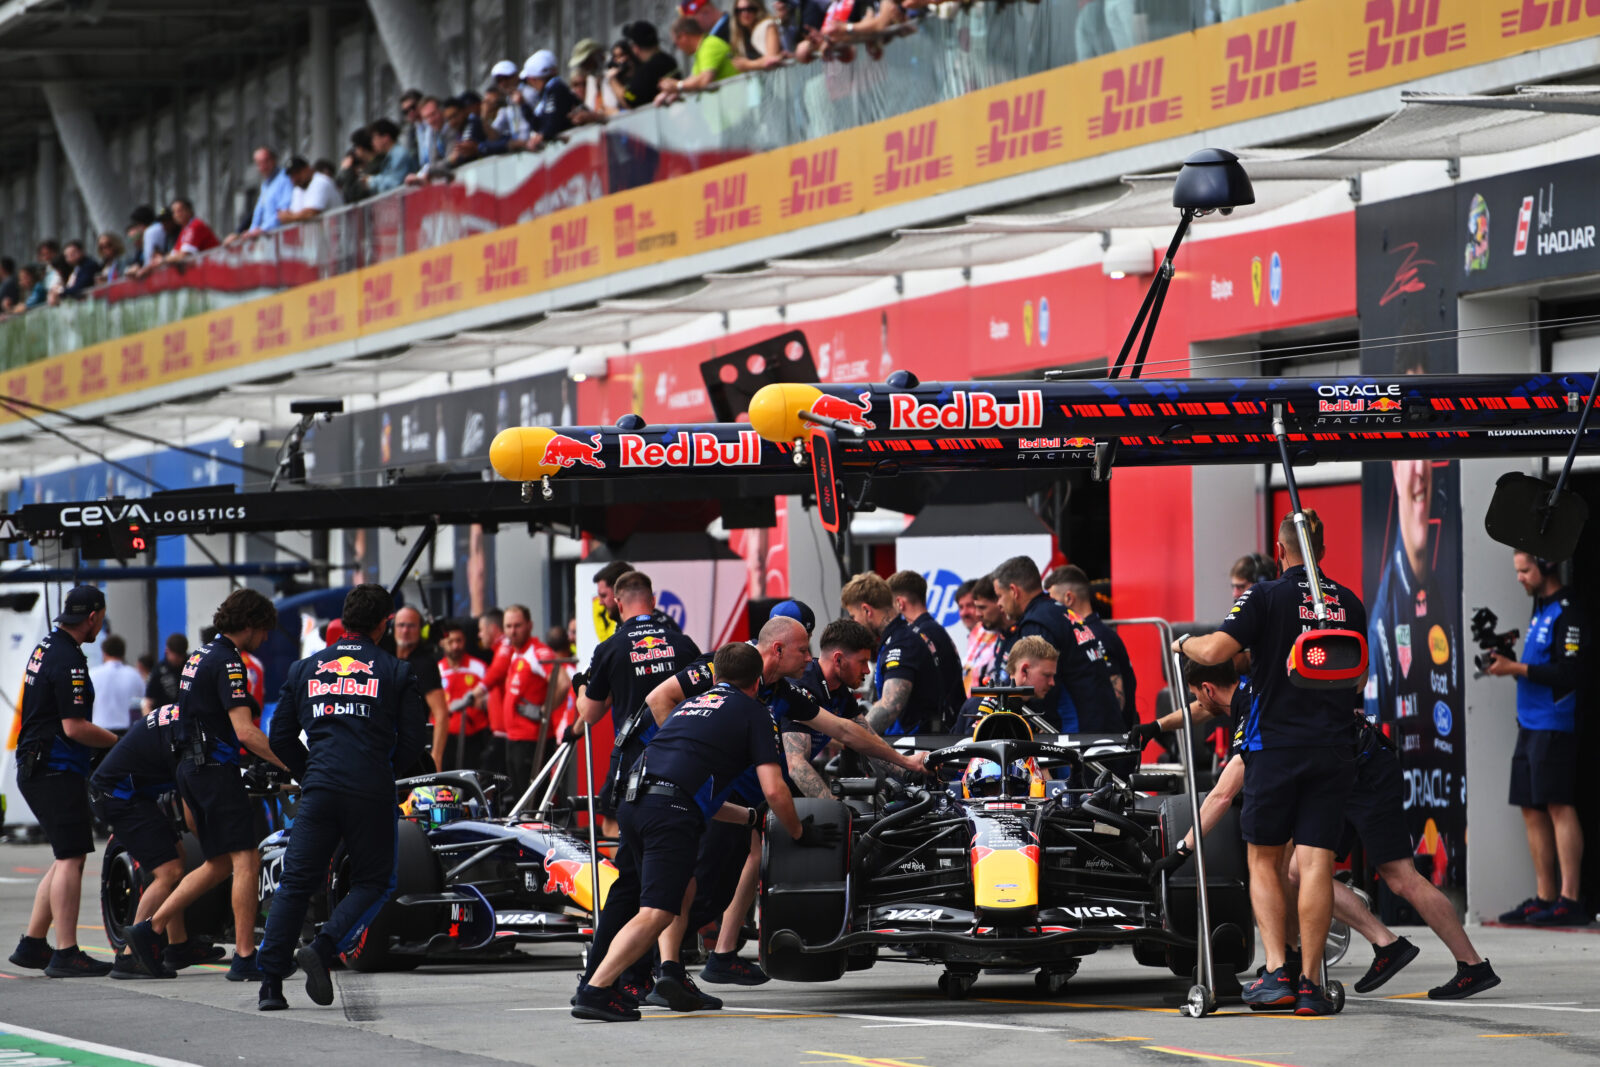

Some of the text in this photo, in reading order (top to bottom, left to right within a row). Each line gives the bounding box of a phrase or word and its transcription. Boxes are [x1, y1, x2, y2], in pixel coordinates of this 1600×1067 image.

[1361, 0, 1453, 73] DHL
[1224, 20, 1304, 106] DHL
[1100, 56, 1170, 140] DHL
[986, 88, 1052, 163] DHL
[883, 119, 943, 193] DHL
[788, 147, 843, 214] DHL
[702, 172, 751, 237] DHL
[549, 217, 590, 276] DHL
[1537, 224, 1596, 257] HADJAR
[1317, 384, 1402, 397] ORACLE
[889, 389, 1043, 430] Red Bull
[1318, 399, 1365, 412] Red Bull
[1317, 415, 1402, 424] RACING
[619, 430, 762, 468] Red Bull
[1018, 437, 1061, 449] Red Bull
[1017, 452, 1095, 460] RACING
[153, 506, 247, 523] LOGISTICS
[1299, 605, 1318, 620] Re
[627, 628, 665, 638] ORACLE
[630, 646, 676, 663] Red Bull
[635, 662, 665, 676] Mobil
[308, 677, 380, 698] Red Bull
[312, 702, 354, 718] Mobil
[940, 745, 968, 756] DAMAC
[1040, 745, 1067, 754] DAMAC
[495, 913, 546, 925] VISA
[887, 908, 944, 921] VISA
[1057, 906, 1127, 918] VISA
